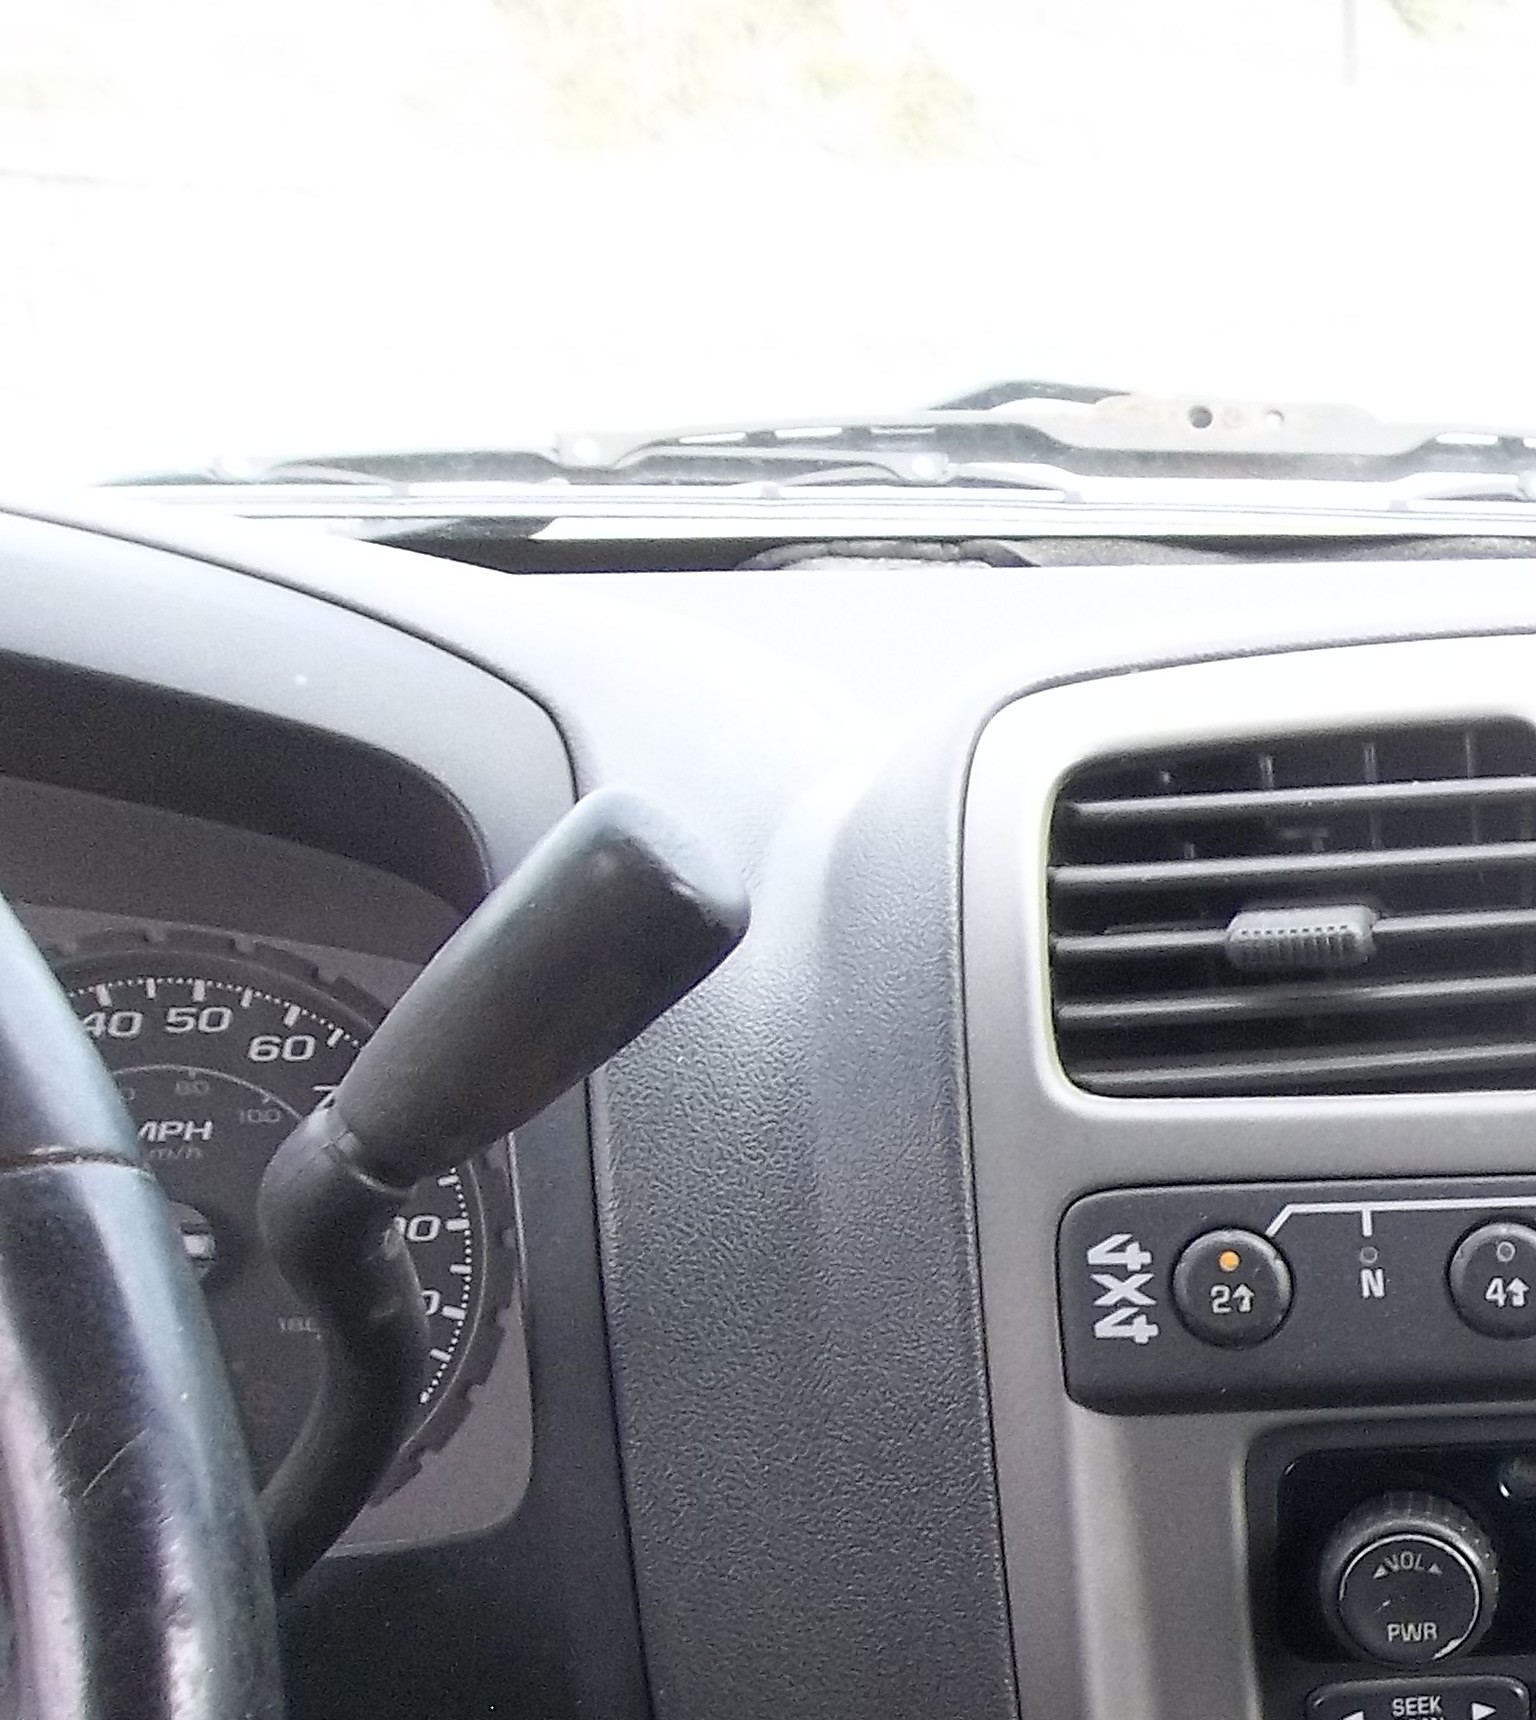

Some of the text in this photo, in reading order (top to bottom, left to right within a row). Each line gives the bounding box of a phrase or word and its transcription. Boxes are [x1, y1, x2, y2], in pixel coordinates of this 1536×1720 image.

[83, 1011, 143, 1037] 40
[164, 1006, 233, 1033] 50
[247, 1035, 316, 1062] 60
[1361, 1268, 1385, 1297] N
[1485, 1277, 1507, 1307] 4
[1210, 1284, 1231, 1314] 2
[1384, 1551, 1425, 1572] VOL
[1387, 1622, 1437, 1642] PWR
[1392, 1696, 1443, 1716] SEEK
